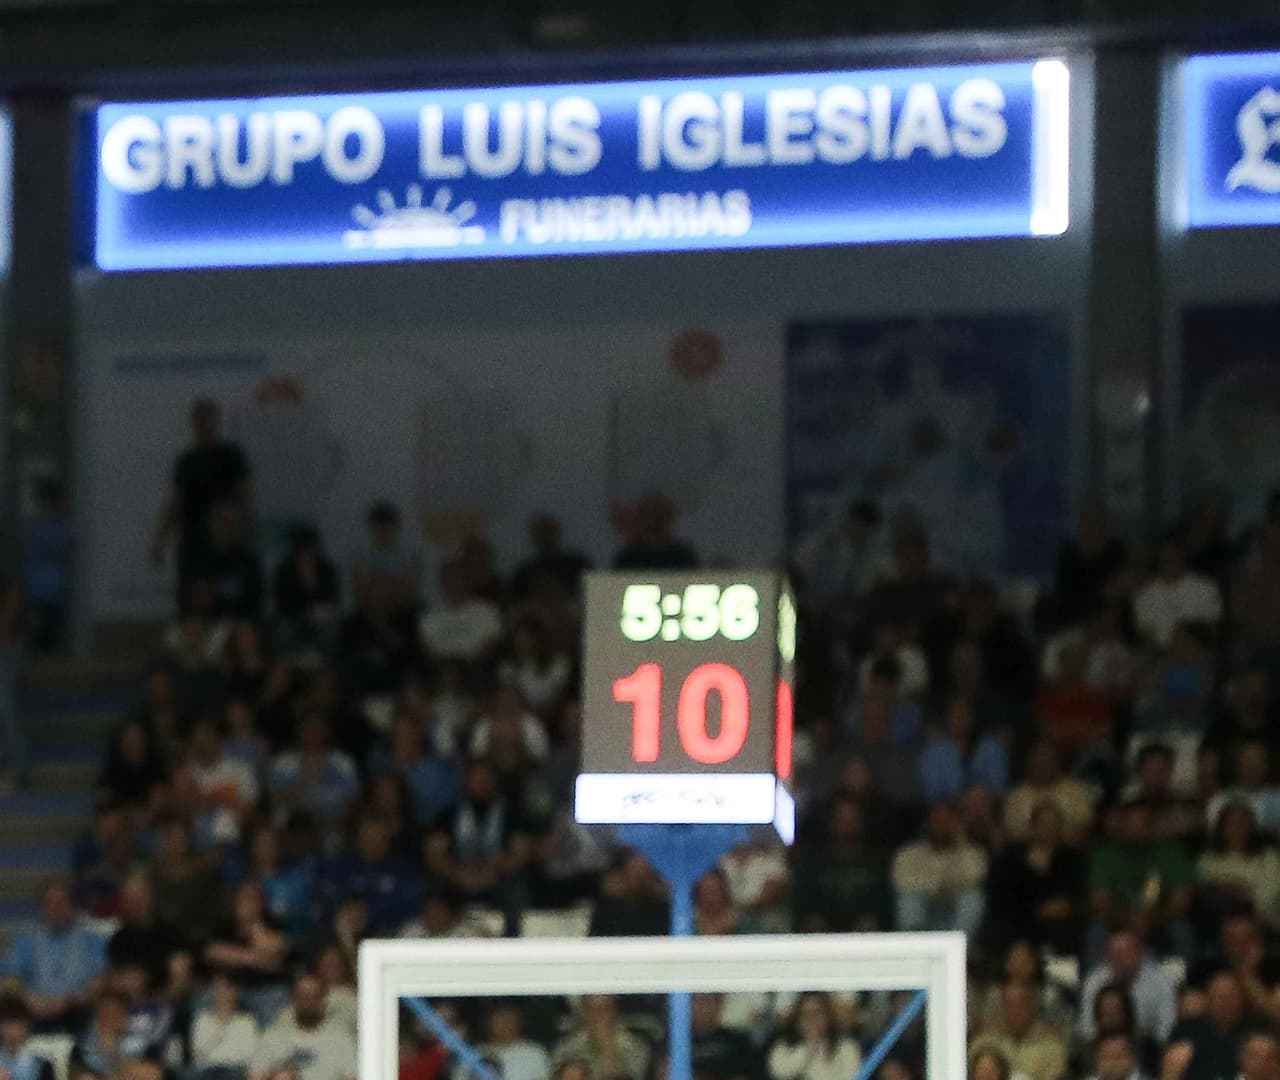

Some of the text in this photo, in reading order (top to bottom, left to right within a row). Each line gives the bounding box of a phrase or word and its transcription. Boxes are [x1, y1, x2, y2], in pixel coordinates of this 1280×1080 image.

[100, 80, 1008, 195] GRUPO LUIS IGLESIAS
[499, 191, 752, 244] FUNERARIAS
[620, 583, 760, 642] 5:56
[612, 662, 750, 764] 10
